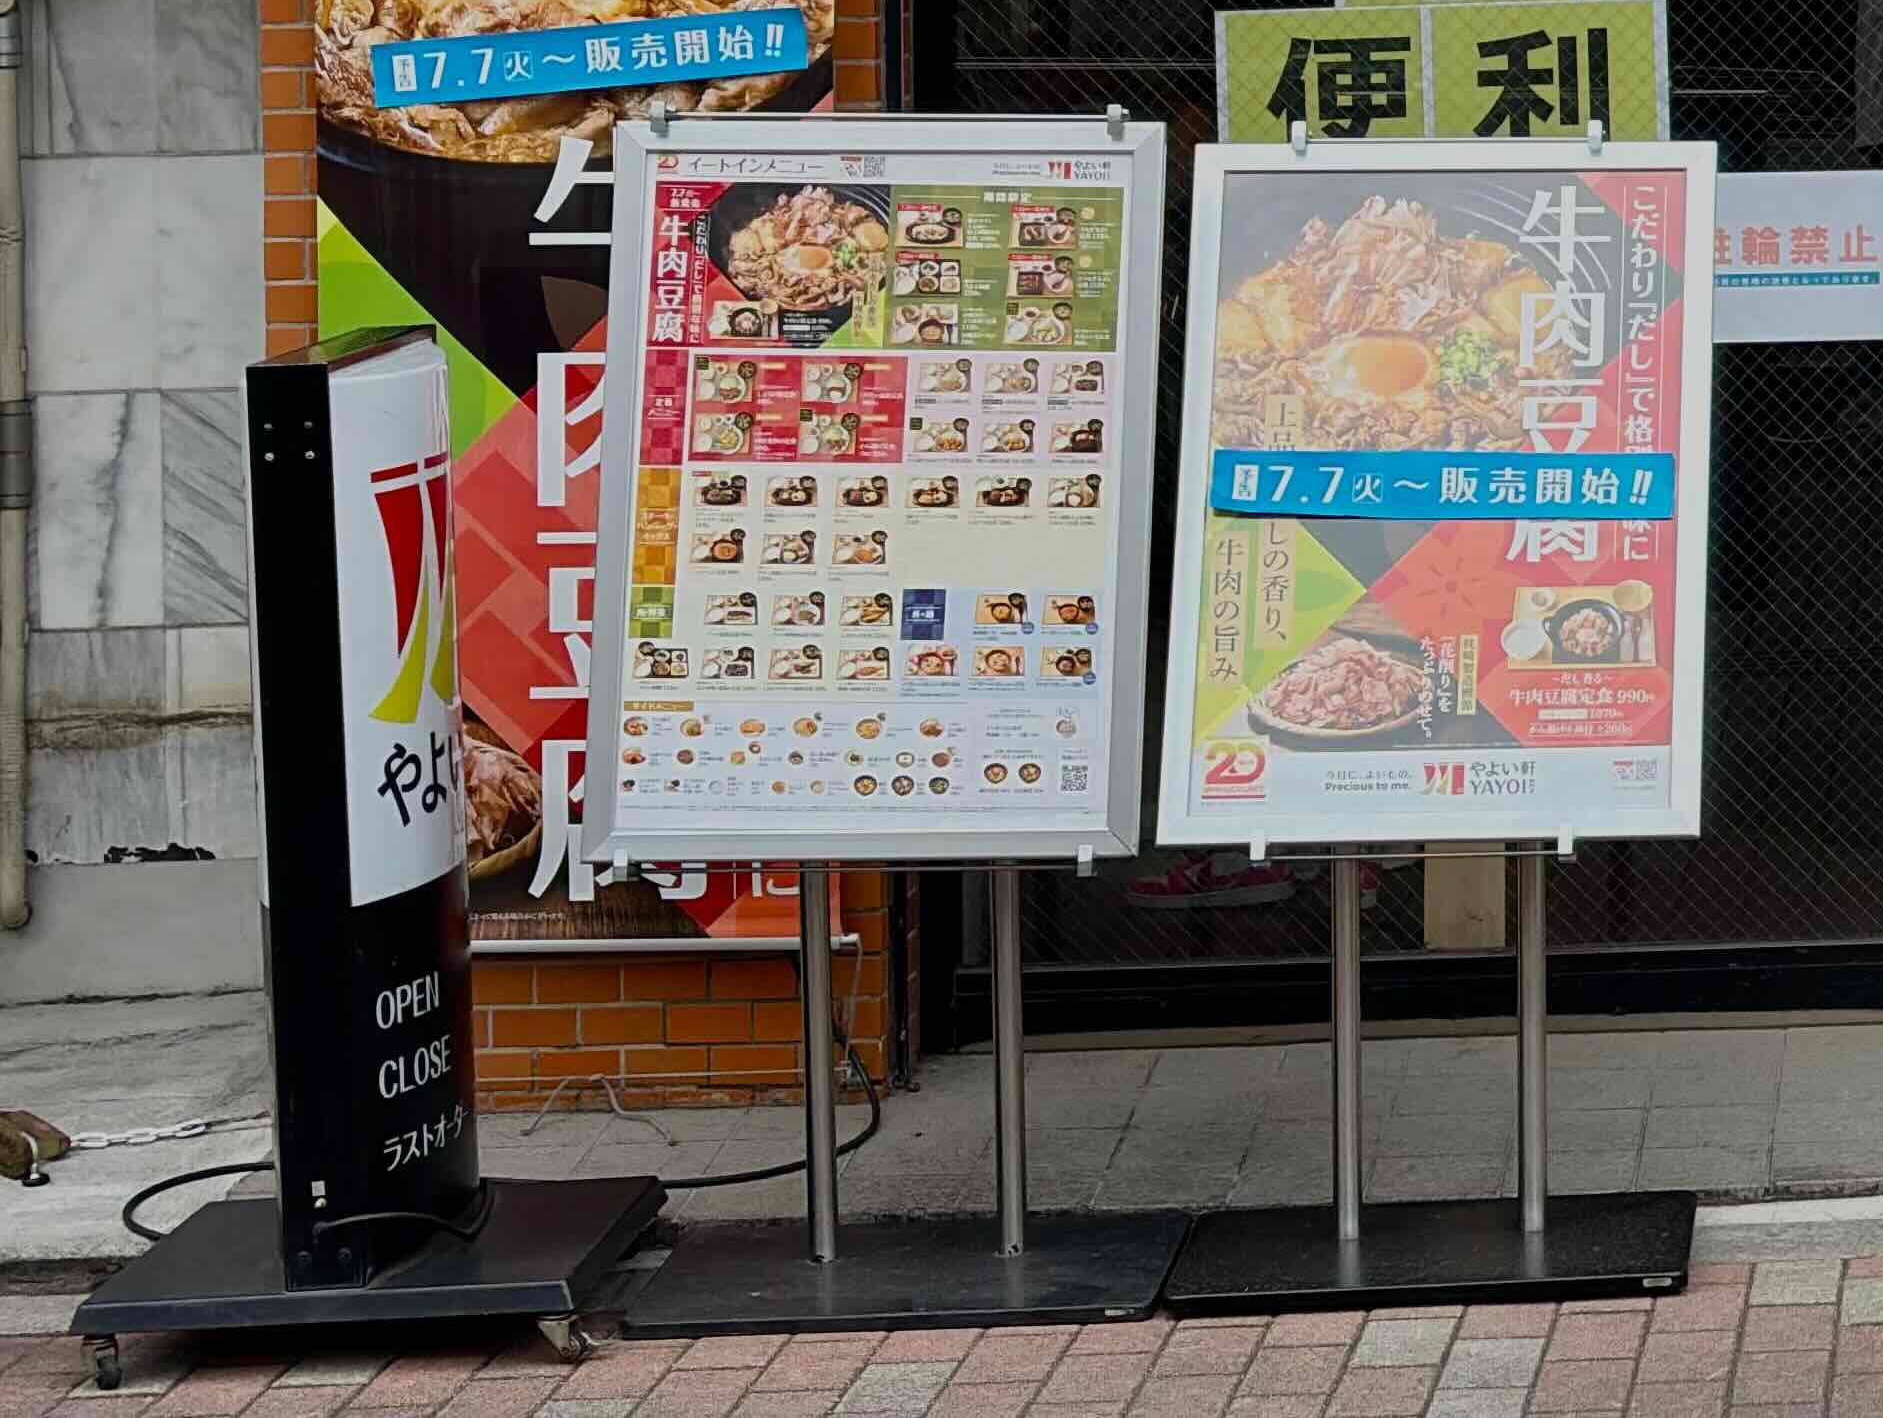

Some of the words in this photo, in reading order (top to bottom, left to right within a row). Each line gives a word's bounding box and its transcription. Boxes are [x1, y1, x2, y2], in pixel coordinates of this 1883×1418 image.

[1267, 26, 1610, 139] 便利
[652, 214, 689, 342] 牛肉豆腐
[1264, 402, 1298, 641] 上品しの香り、
[1209, 538, 1245, 682] 牛肉の旨み
[1470, 778, 1526, 795] YAYOI
[376, 970, 440, 1031] OPEN
[378, 1034, 452, 1099] CLOSE
